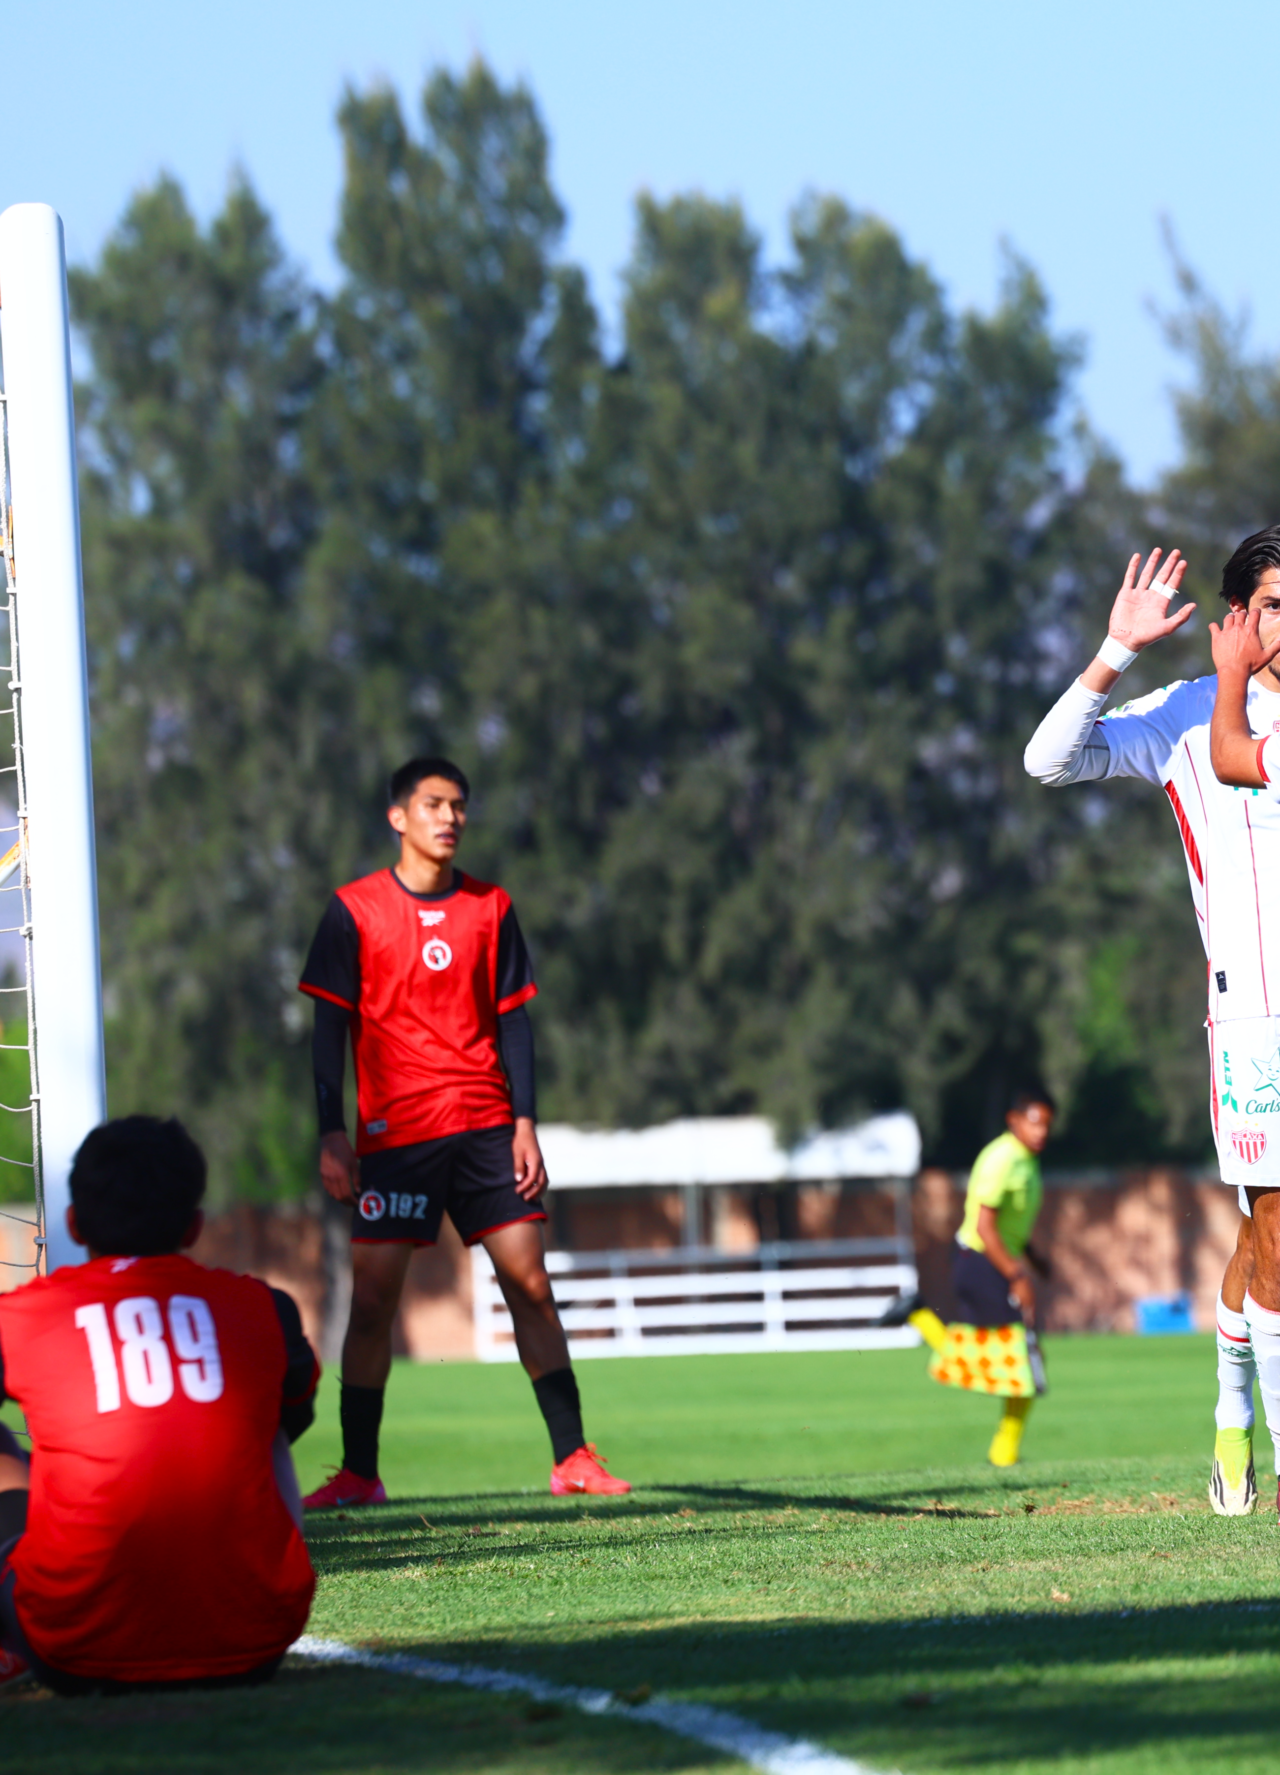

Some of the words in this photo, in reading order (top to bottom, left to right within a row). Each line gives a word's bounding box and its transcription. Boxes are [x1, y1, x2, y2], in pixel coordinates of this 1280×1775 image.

[1223, 1050, 1232, 1087] ETN
[1245, 1098, 1280, 1115] Carl's
[388, 1191, 428, 1219] 192
[75, 1294, 224, 1414] 189
